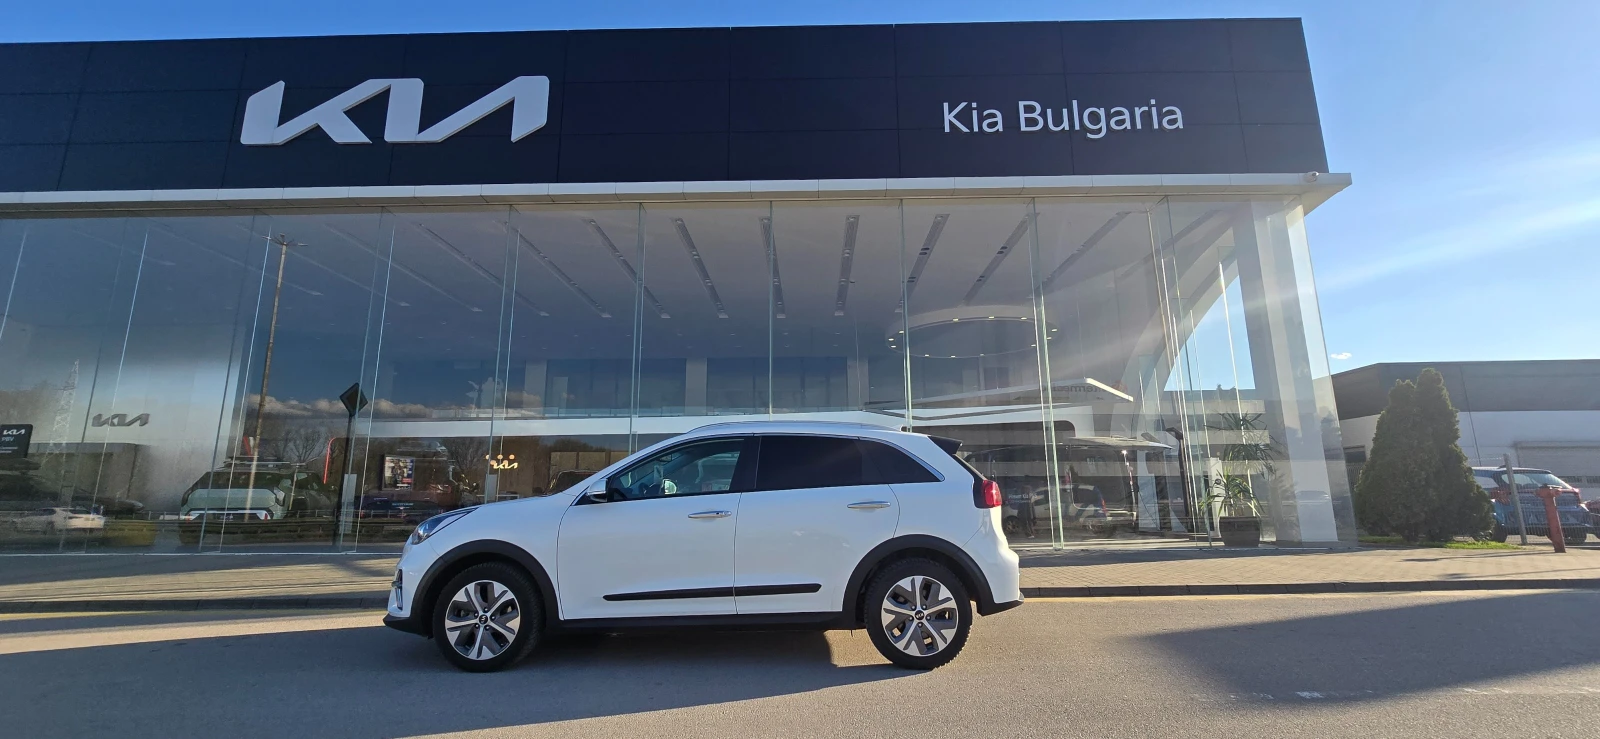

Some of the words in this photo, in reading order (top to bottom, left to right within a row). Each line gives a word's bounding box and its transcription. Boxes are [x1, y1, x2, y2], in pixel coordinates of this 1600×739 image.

[240, 75, 550, 145] KIA
[943, 102, 1004, 133] Kia
[1018, 98, 1184, 139] Bulgaria
